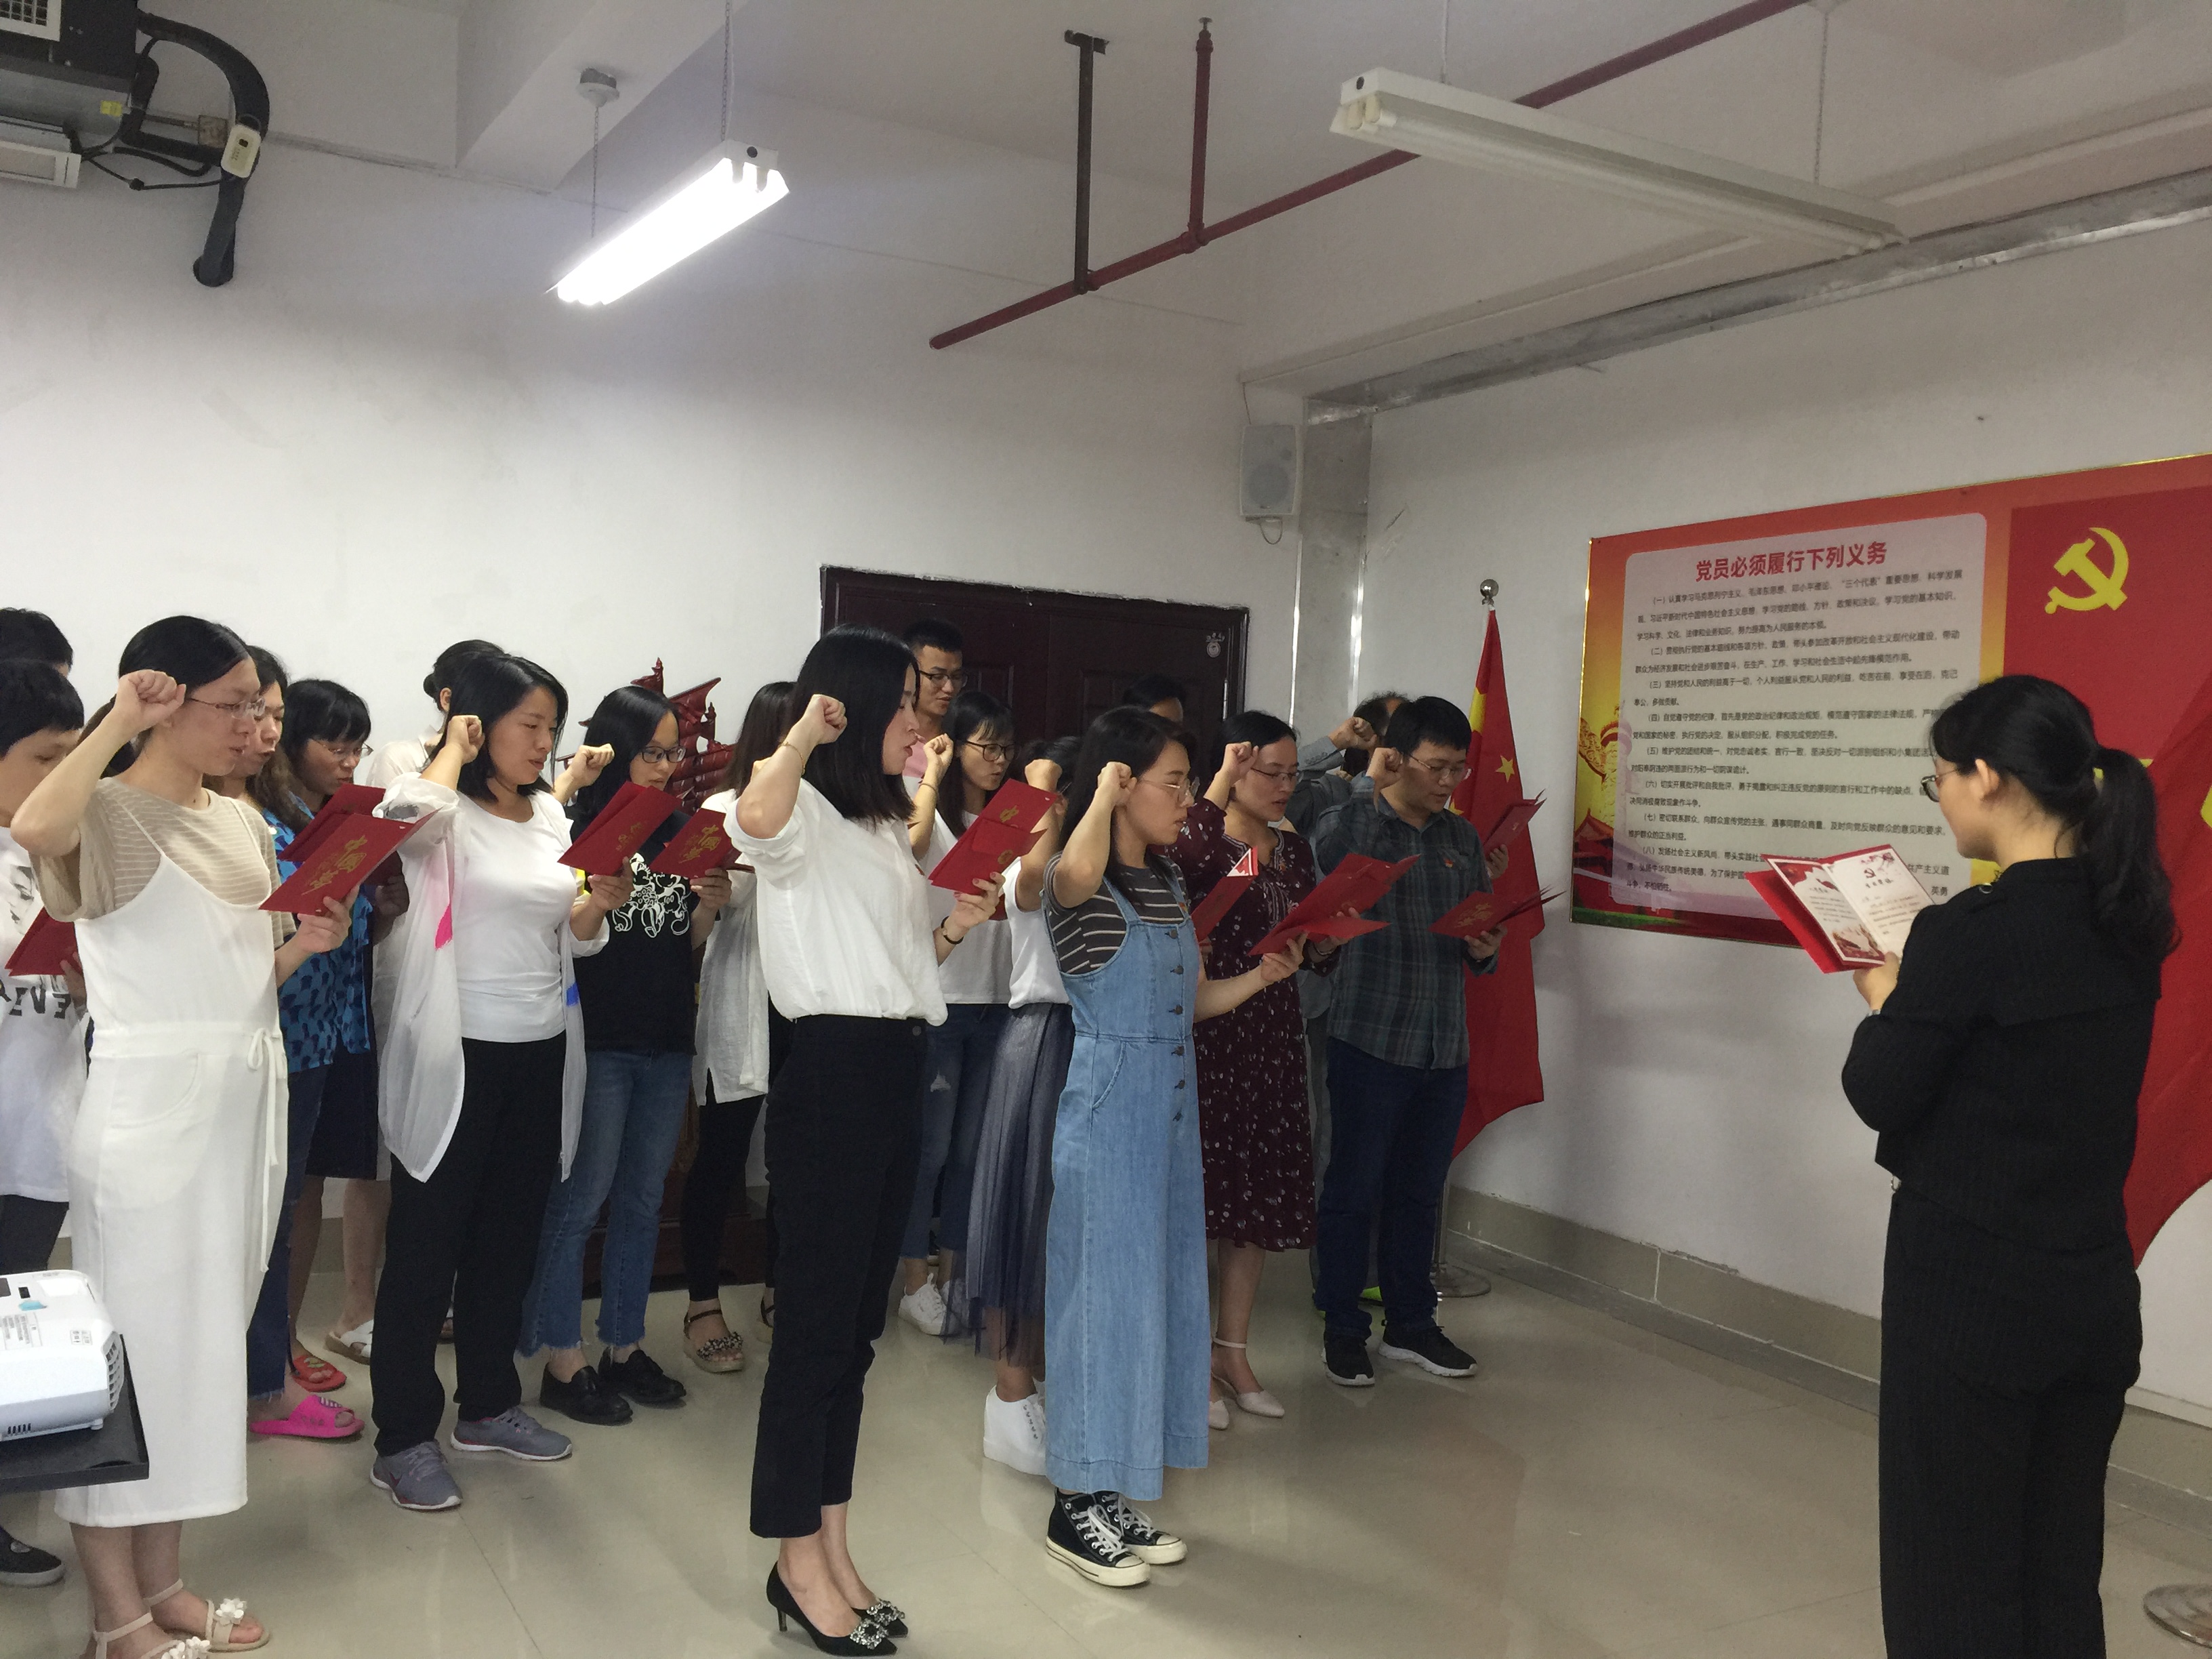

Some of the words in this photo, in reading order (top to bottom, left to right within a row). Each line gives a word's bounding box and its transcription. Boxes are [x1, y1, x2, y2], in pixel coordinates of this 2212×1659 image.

[1695, 539, 1887, 583] 党员必须履行下列义务
[1930, 885, 1948, 897] 英勇
